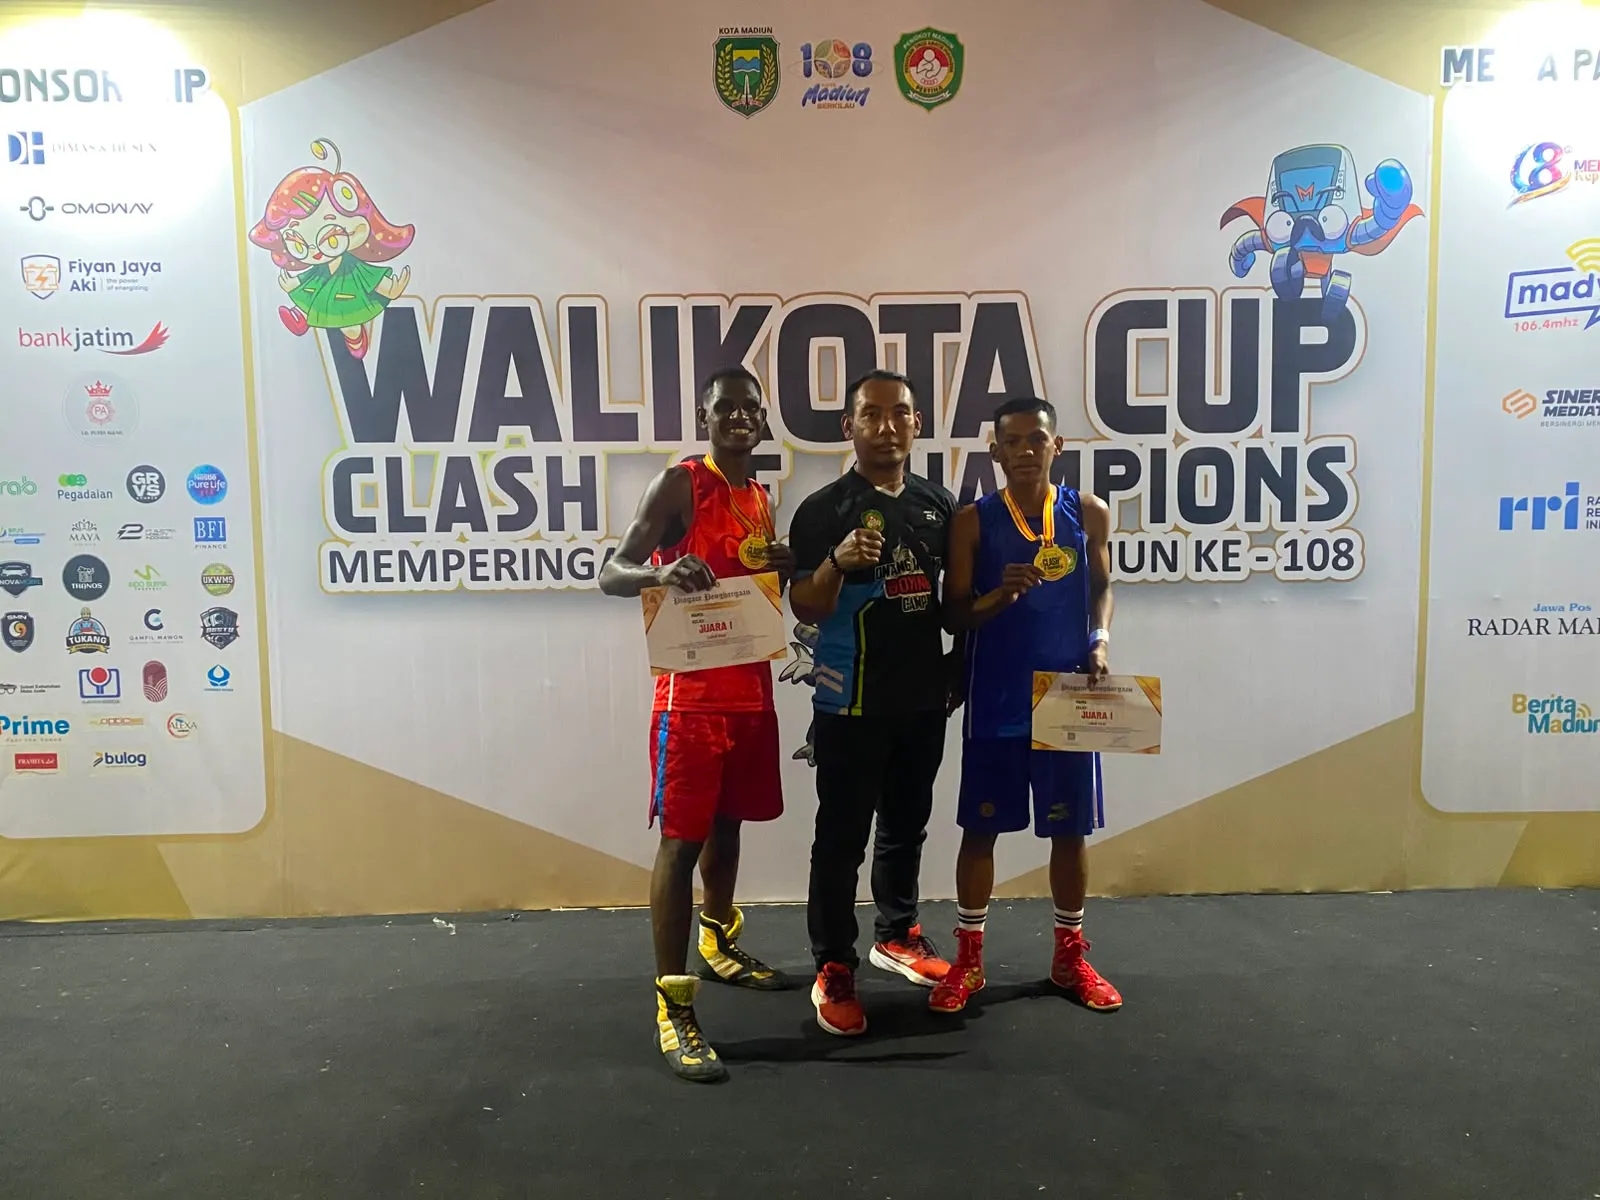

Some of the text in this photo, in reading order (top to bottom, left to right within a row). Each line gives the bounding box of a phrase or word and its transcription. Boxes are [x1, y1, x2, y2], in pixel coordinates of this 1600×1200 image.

[718, 26, 773, 35] KOTA MADIUN
[801, 83, 871, 107] Madiun
[817, 102, 856, 110] BERKILAU
[61, 202, 154, 215] OMOWAY
[68, 258, 162, 277] Fiyan Jaya
[69, 277, 97, 292] Aki
[1513, 318, 1579, 333] 106.4mhz
[326, 298, 1357, 444] WALIKOTA CUP
[188, 480, 226, 491] Pure Life
[57, 489, 113, 502] Pegadaian
[331, 454, 599, 533] CLASH
[195, 520, 225, 539] BFI
[69, 534, 101, 542] MAYA
[1194, 539, 1242, 573] KE
[1283, 537, 1355, 572] 108
[1533, 602, 1592, 613] Jawa Pos
[699, 621, 728, 634] JUARA
[1467, 618, 1552, 637] RADAR
[68, 635, 107, 645] TUKANG
[1512, 693, 1577, 714] Berita
[1081, 711, 1108, 720] JUARA
[170, 720, 199, 730] ALEXA
[104, 752, 147, 767] bulog
